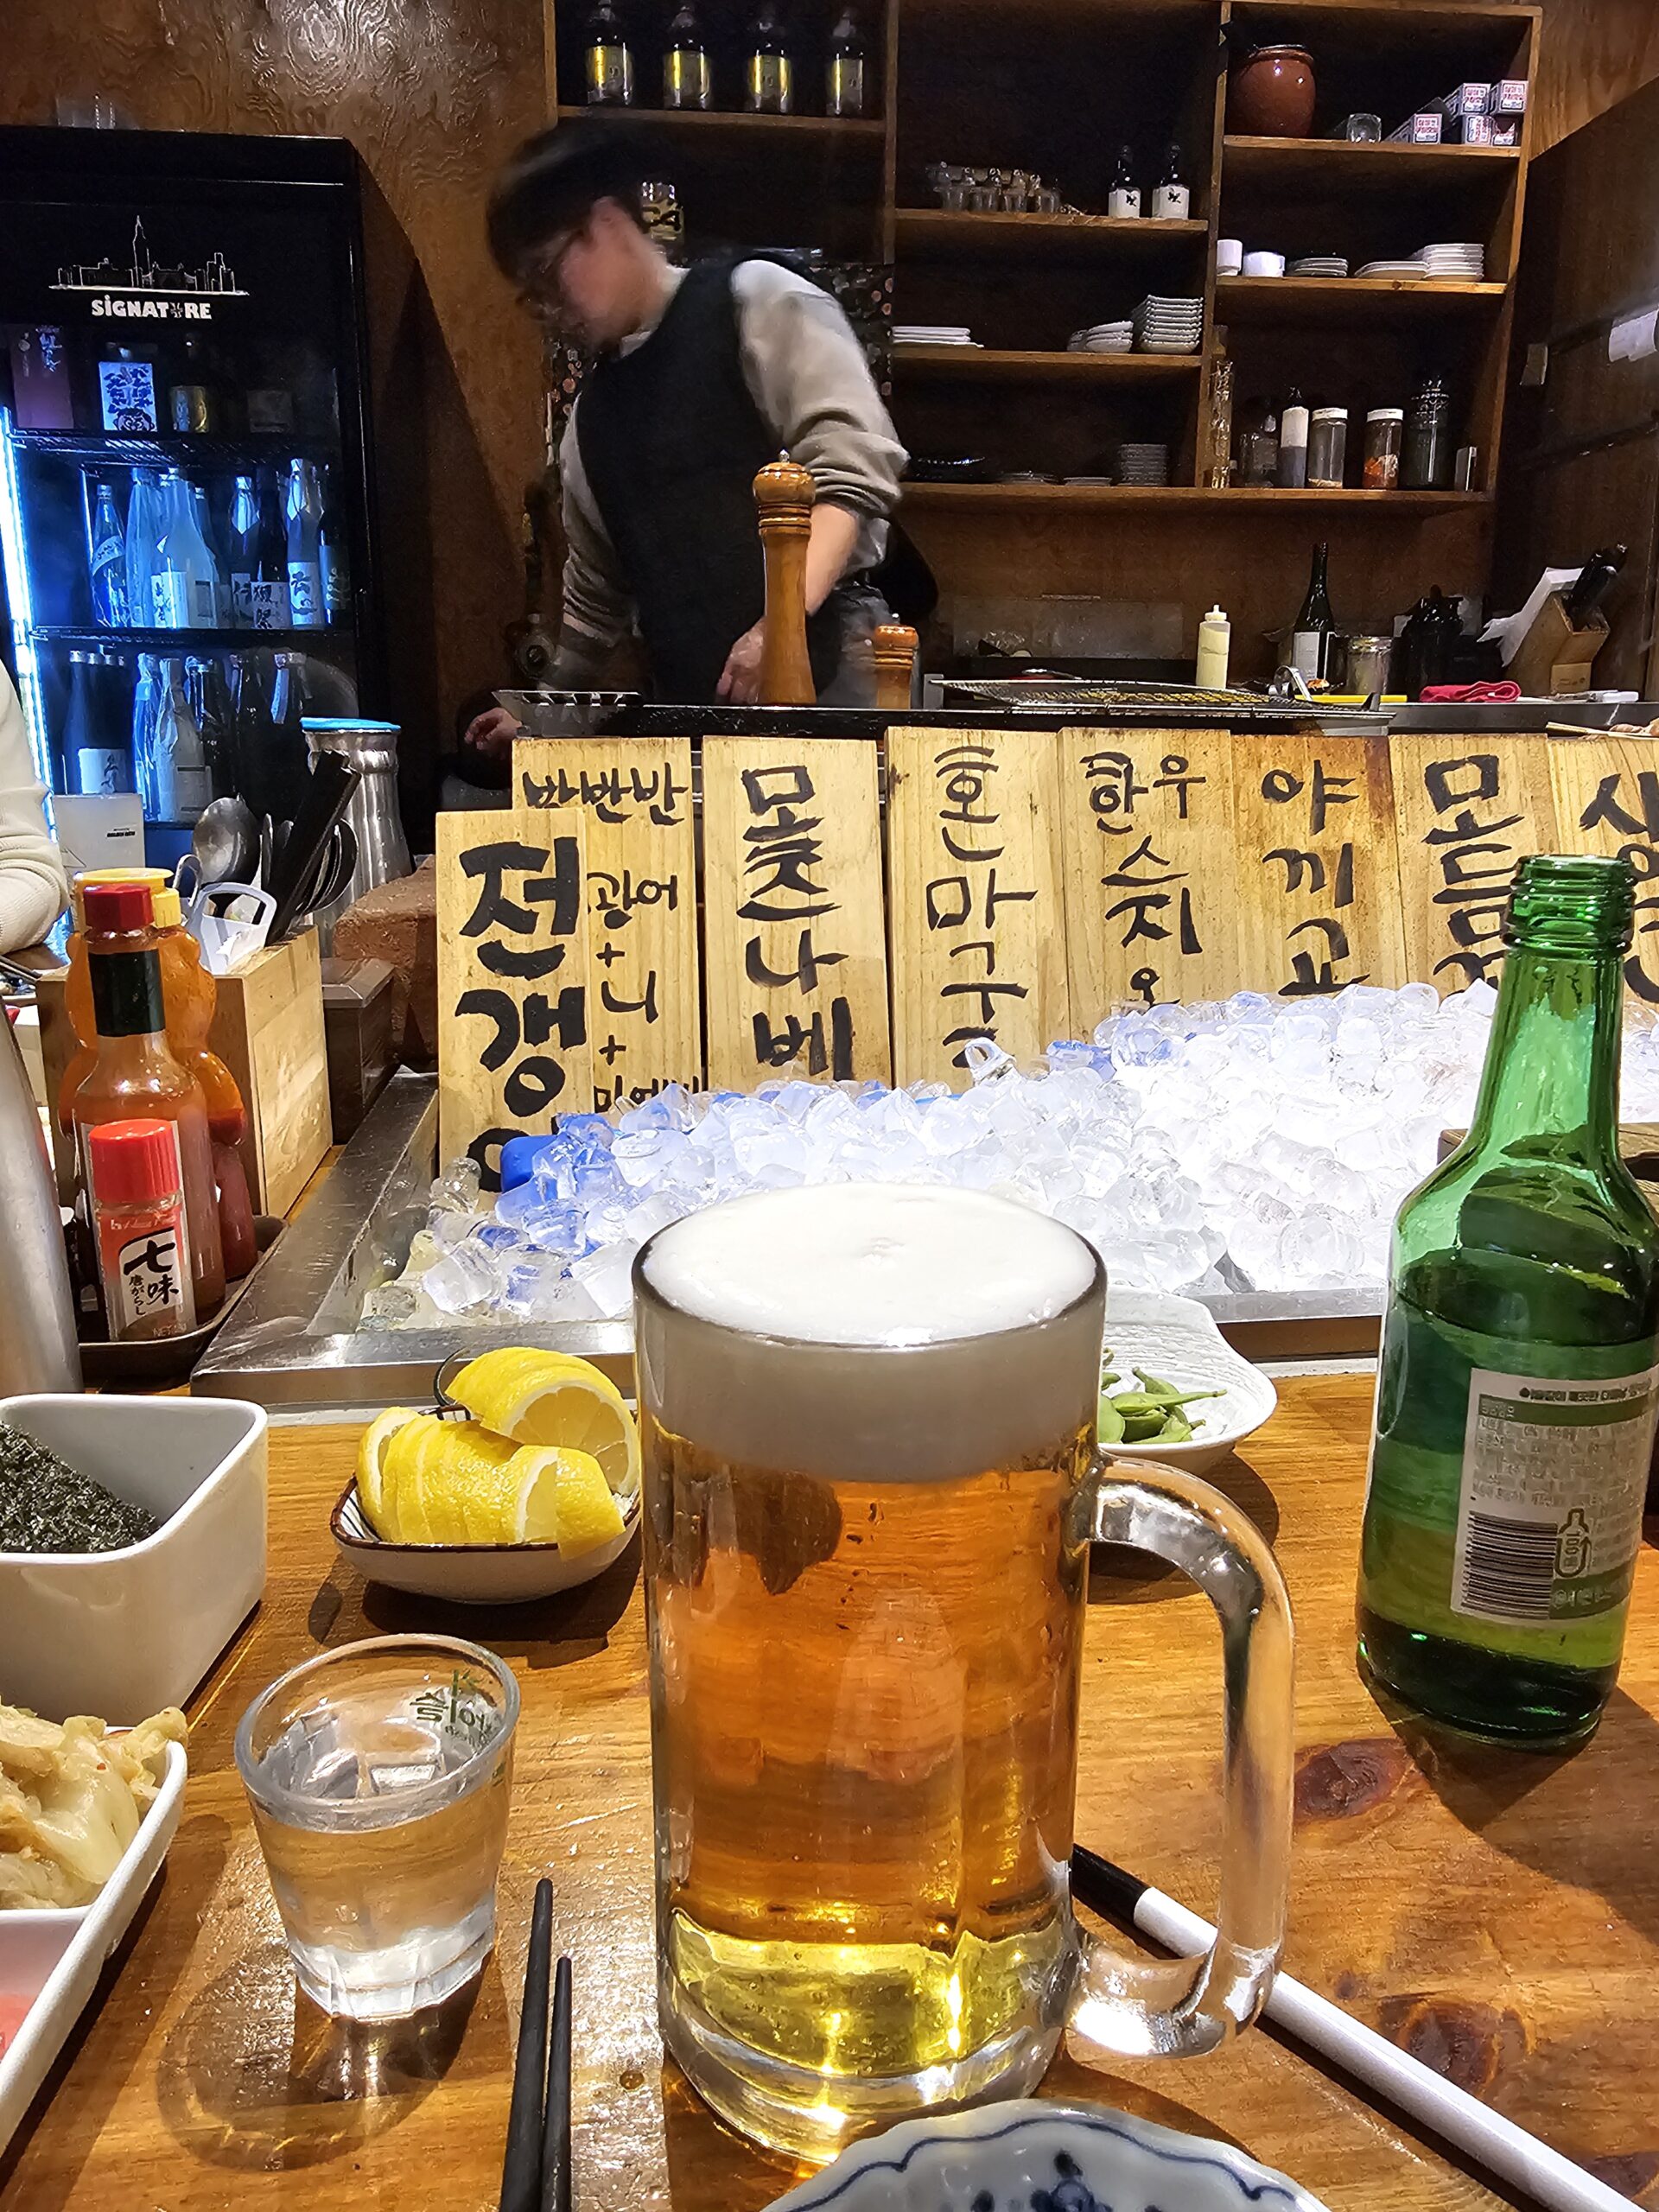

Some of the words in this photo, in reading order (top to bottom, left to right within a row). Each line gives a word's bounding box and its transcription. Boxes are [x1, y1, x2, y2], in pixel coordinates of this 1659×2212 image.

[522, 762, 689, 825] 반반반
[1080, 751, 1206, 836] 한우
[587, 869, 678, 930] 광어
[737, 764, 855, 1081] 모츠나베
[124, 1239, 179, 1306] 七味
